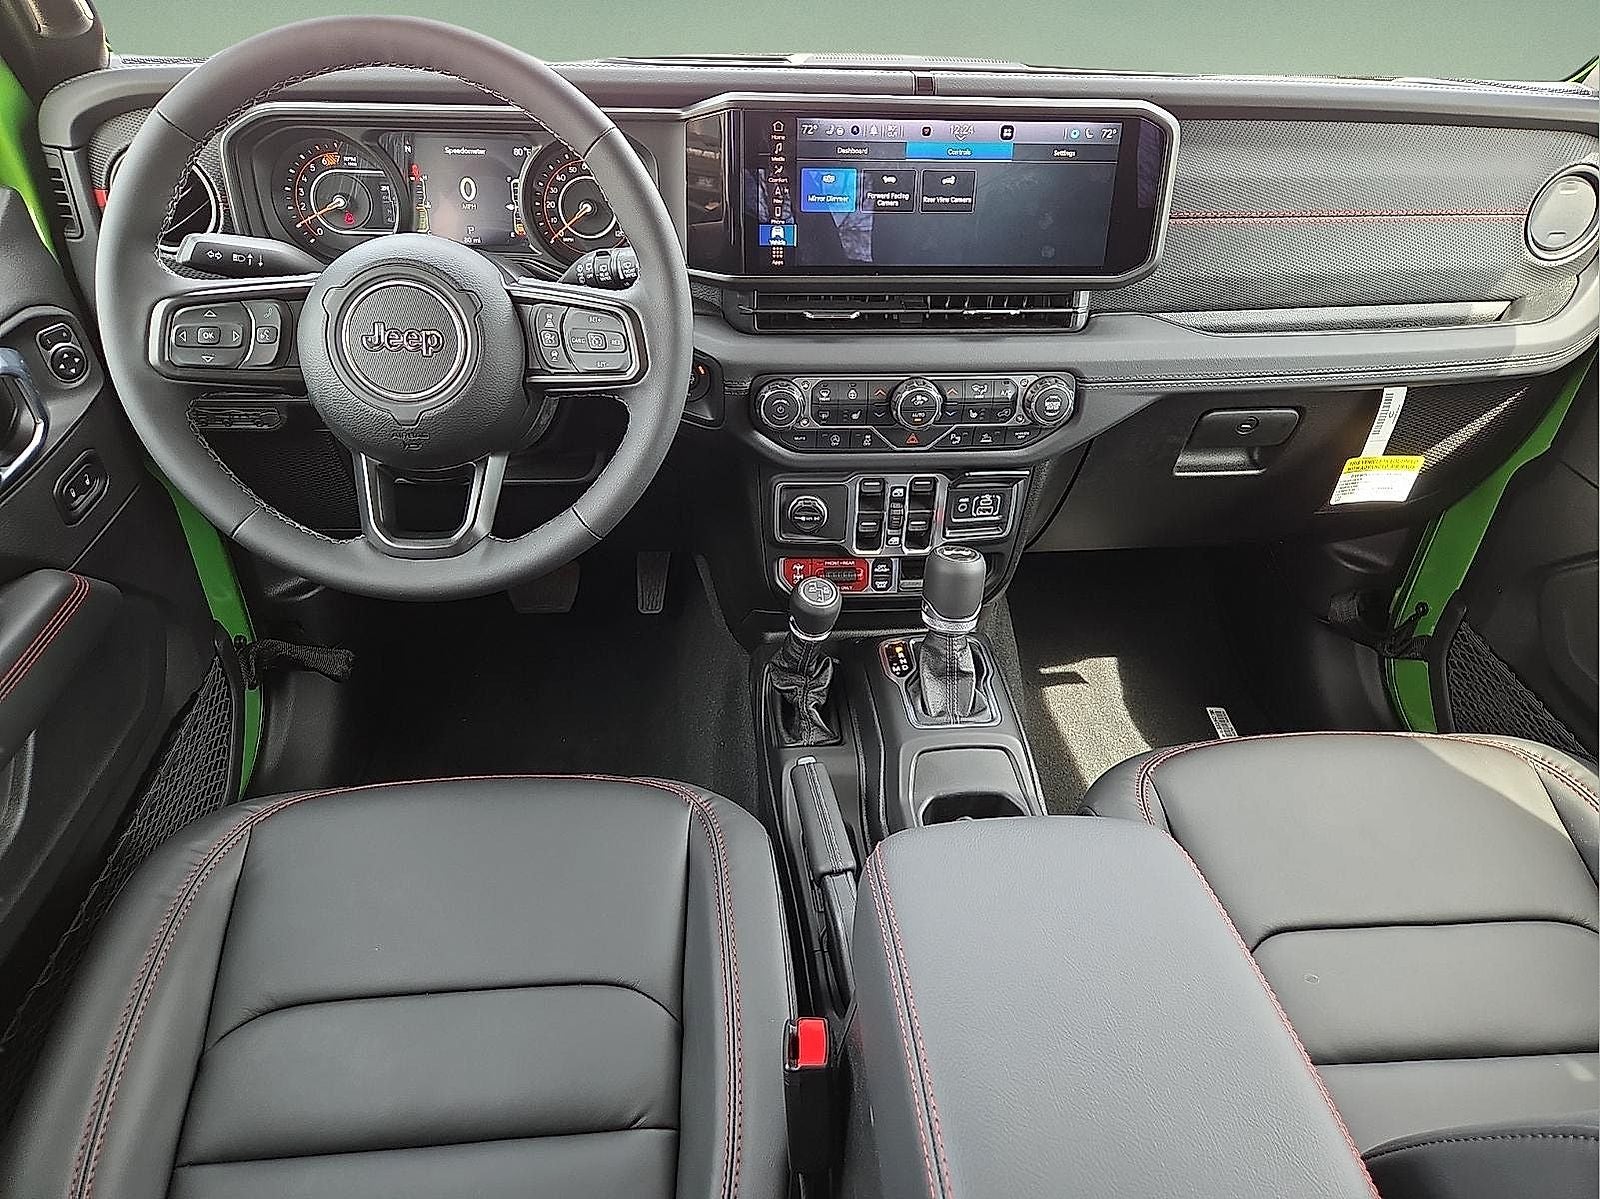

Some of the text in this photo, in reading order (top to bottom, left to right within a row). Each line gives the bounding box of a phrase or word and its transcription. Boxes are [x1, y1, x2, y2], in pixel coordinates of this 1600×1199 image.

[950, 125, 974, 135] 12:24
[1102, 128, 1118, 138] 72°
[444, 146, 486, 156] Speedometer
[322, 158, 328, 166] 6
[310, 164, 316, 172] 5
[302, 174, 308, 182] 4
[556, 174, 566, 182] 40
[299, 188, 304, 196] 3
[460, 176, 477, 202] 0
[891, 192, 910, 200] Facing
[300, 202, 306, 210] 2
[317, 228, 324, 236] 0
[468, 226, 475, 234] P
[361, 322, 445, 358] Jeep
